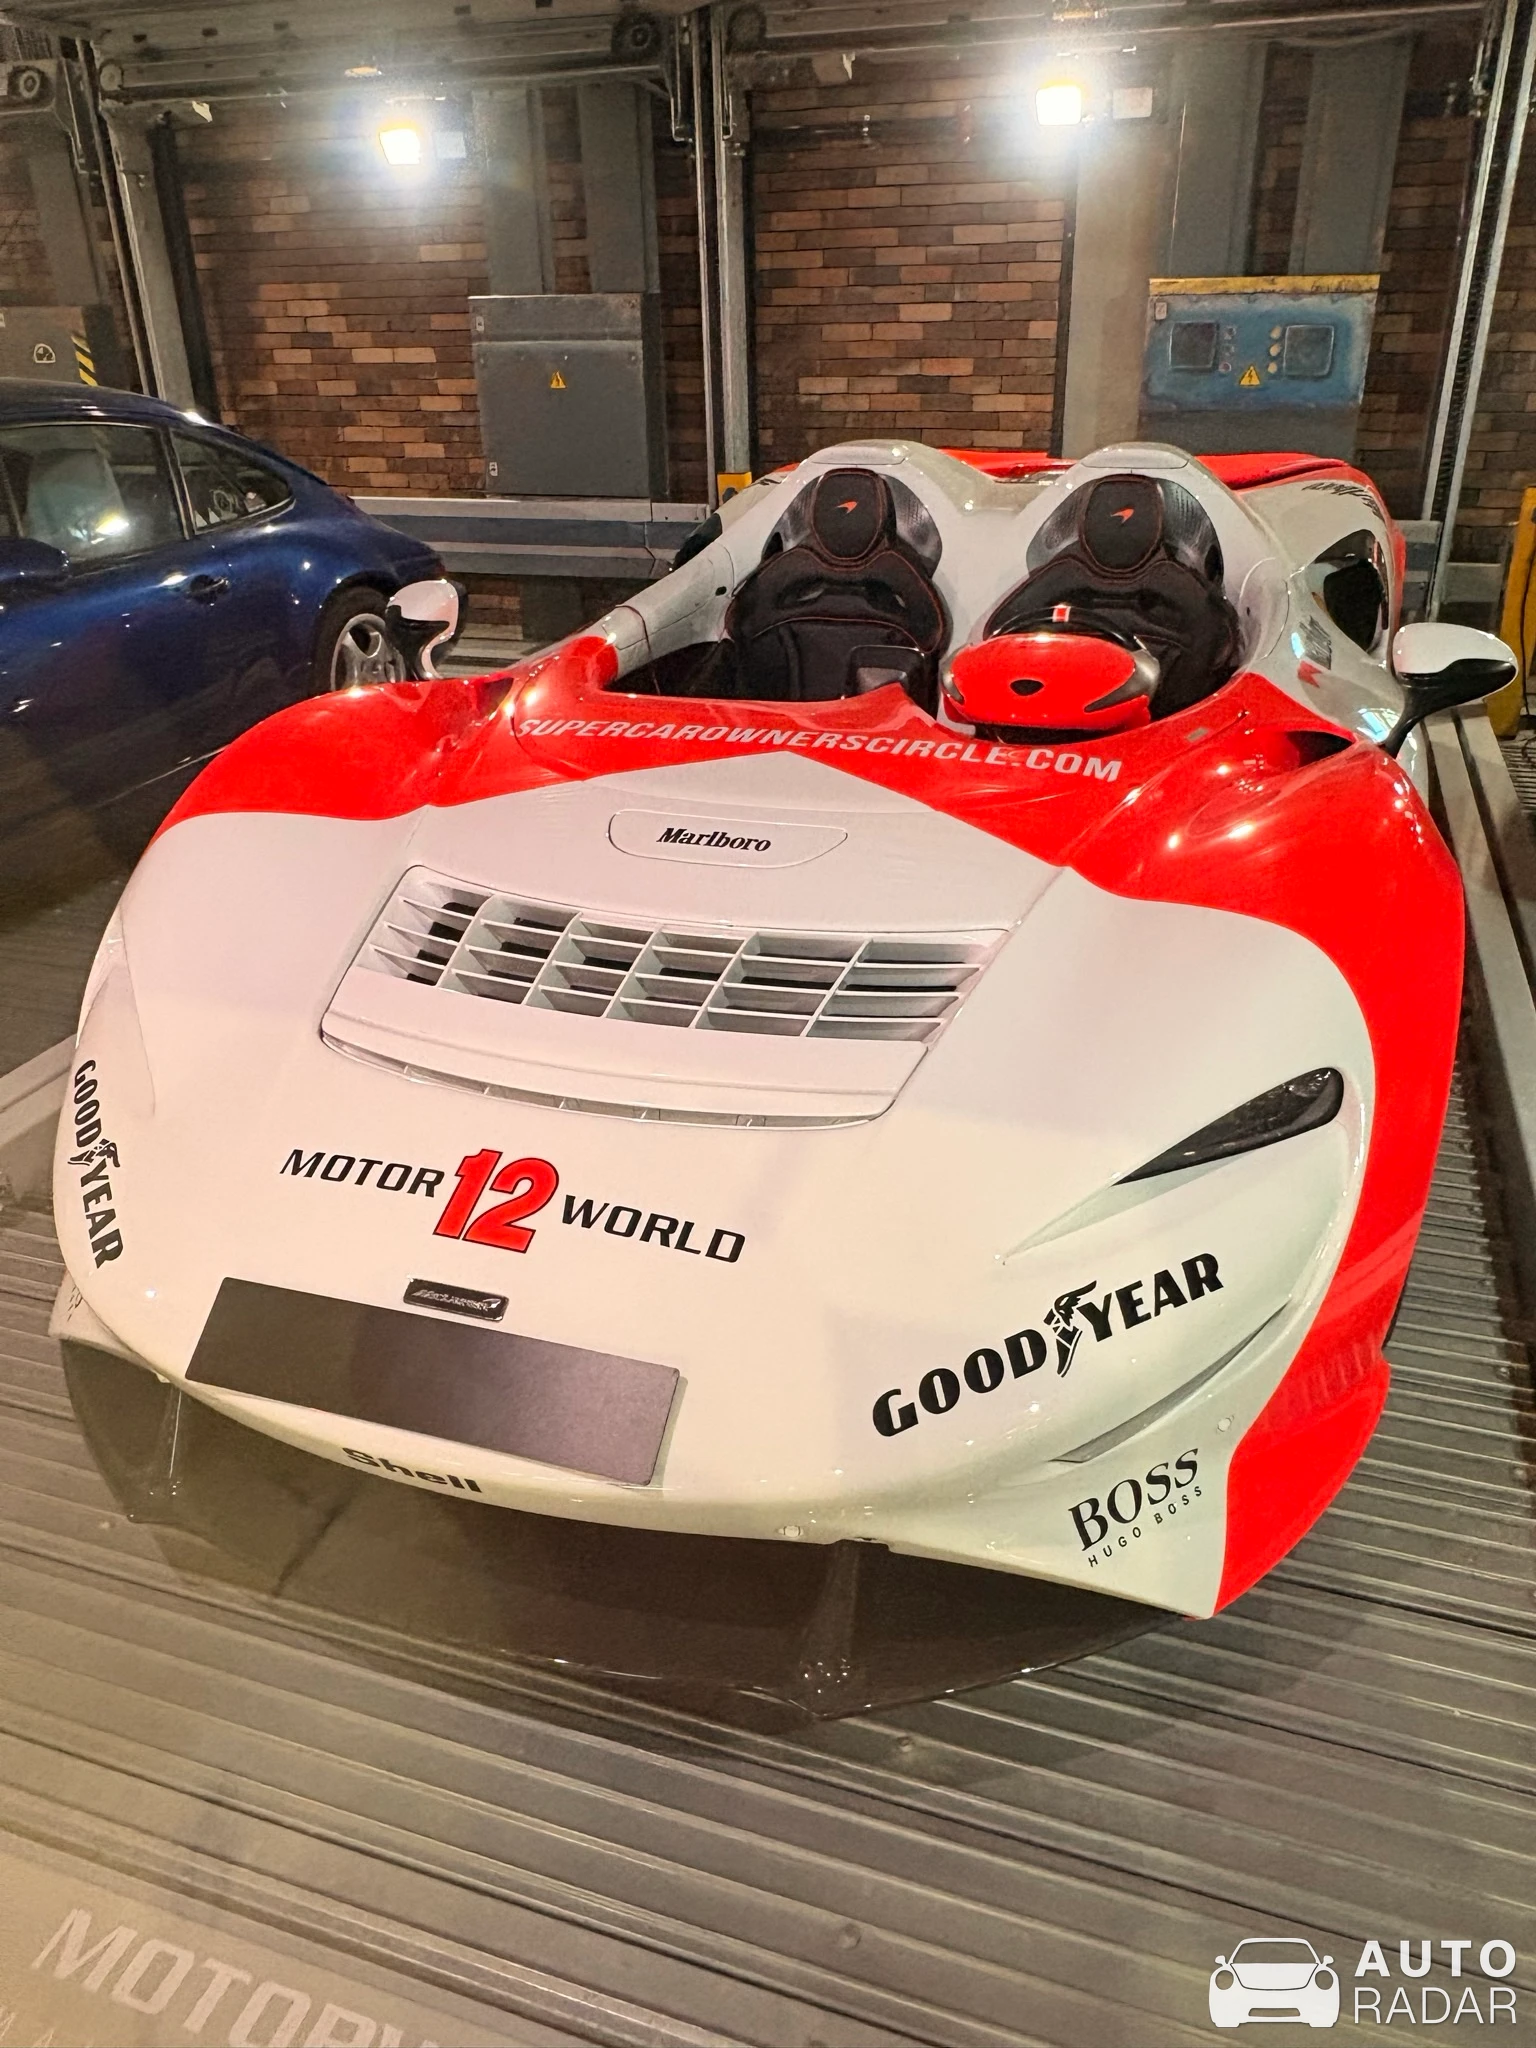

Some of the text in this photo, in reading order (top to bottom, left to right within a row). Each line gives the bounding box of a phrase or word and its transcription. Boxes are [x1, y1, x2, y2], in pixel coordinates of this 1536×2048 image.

[515, 718, 1122, 783] SUPERCAROWNERSCIRCLE.COM
[656, 826, 771, 854] Marlboro
[279, 1149, 746, 1264] MOTOR 12 WORLD
[342, 1446, 483, 1494] Shell
[1067, 1448, 1200, 1552] BOSS
[1087, 1486, 1203, 1568] HUGO BOSS
[30, 1908, 442, 2047] MOTOR
